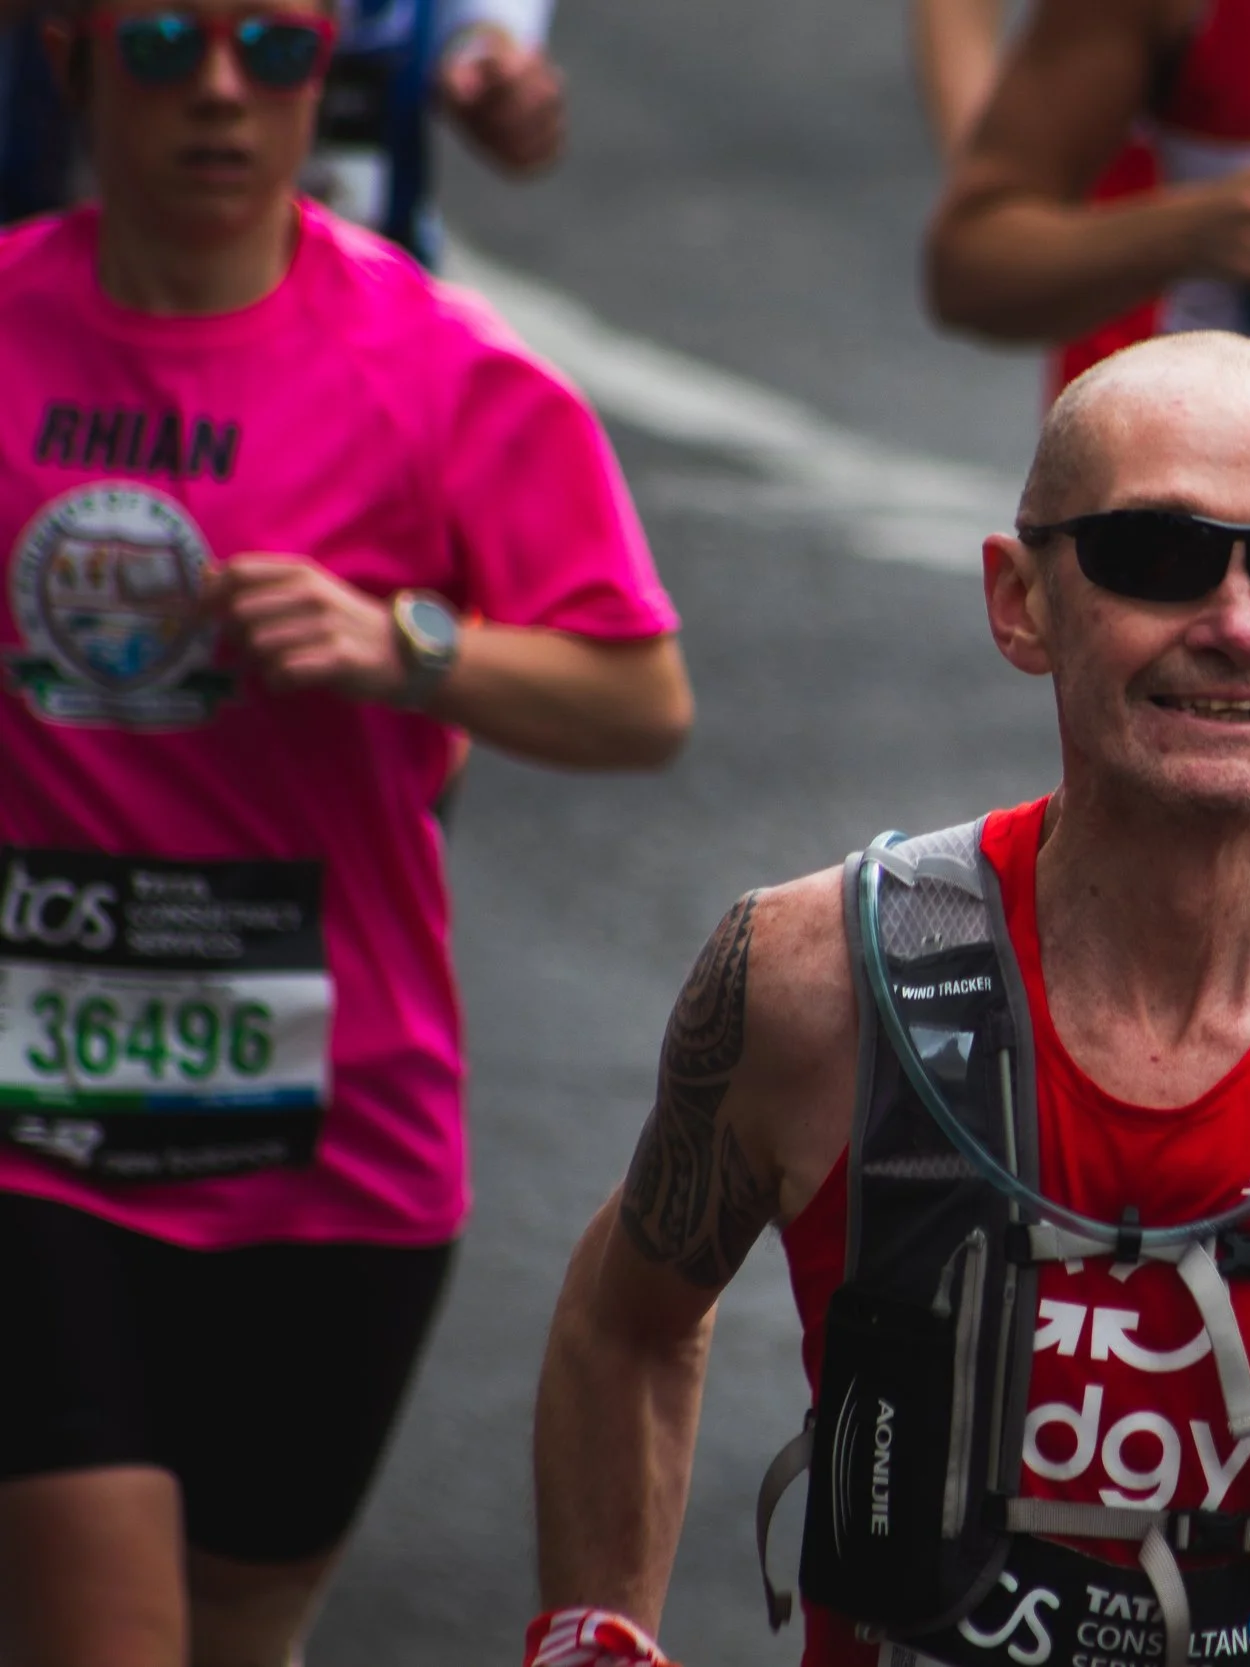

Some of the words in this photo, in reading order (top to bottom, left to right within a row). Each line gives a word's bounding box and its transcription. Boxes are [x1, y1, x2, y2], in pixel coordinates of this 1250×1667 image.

[36, 402, 241, 481] RHIAN
[902, 985, 934, 1000] WIND
[939, 976, 992, 996] TRACKER
[27, 993, 274, 1080] 36496
[871, 1398, 895, 1536] AONIJIE
[1086, 1584, 1163, 1623] TAT
